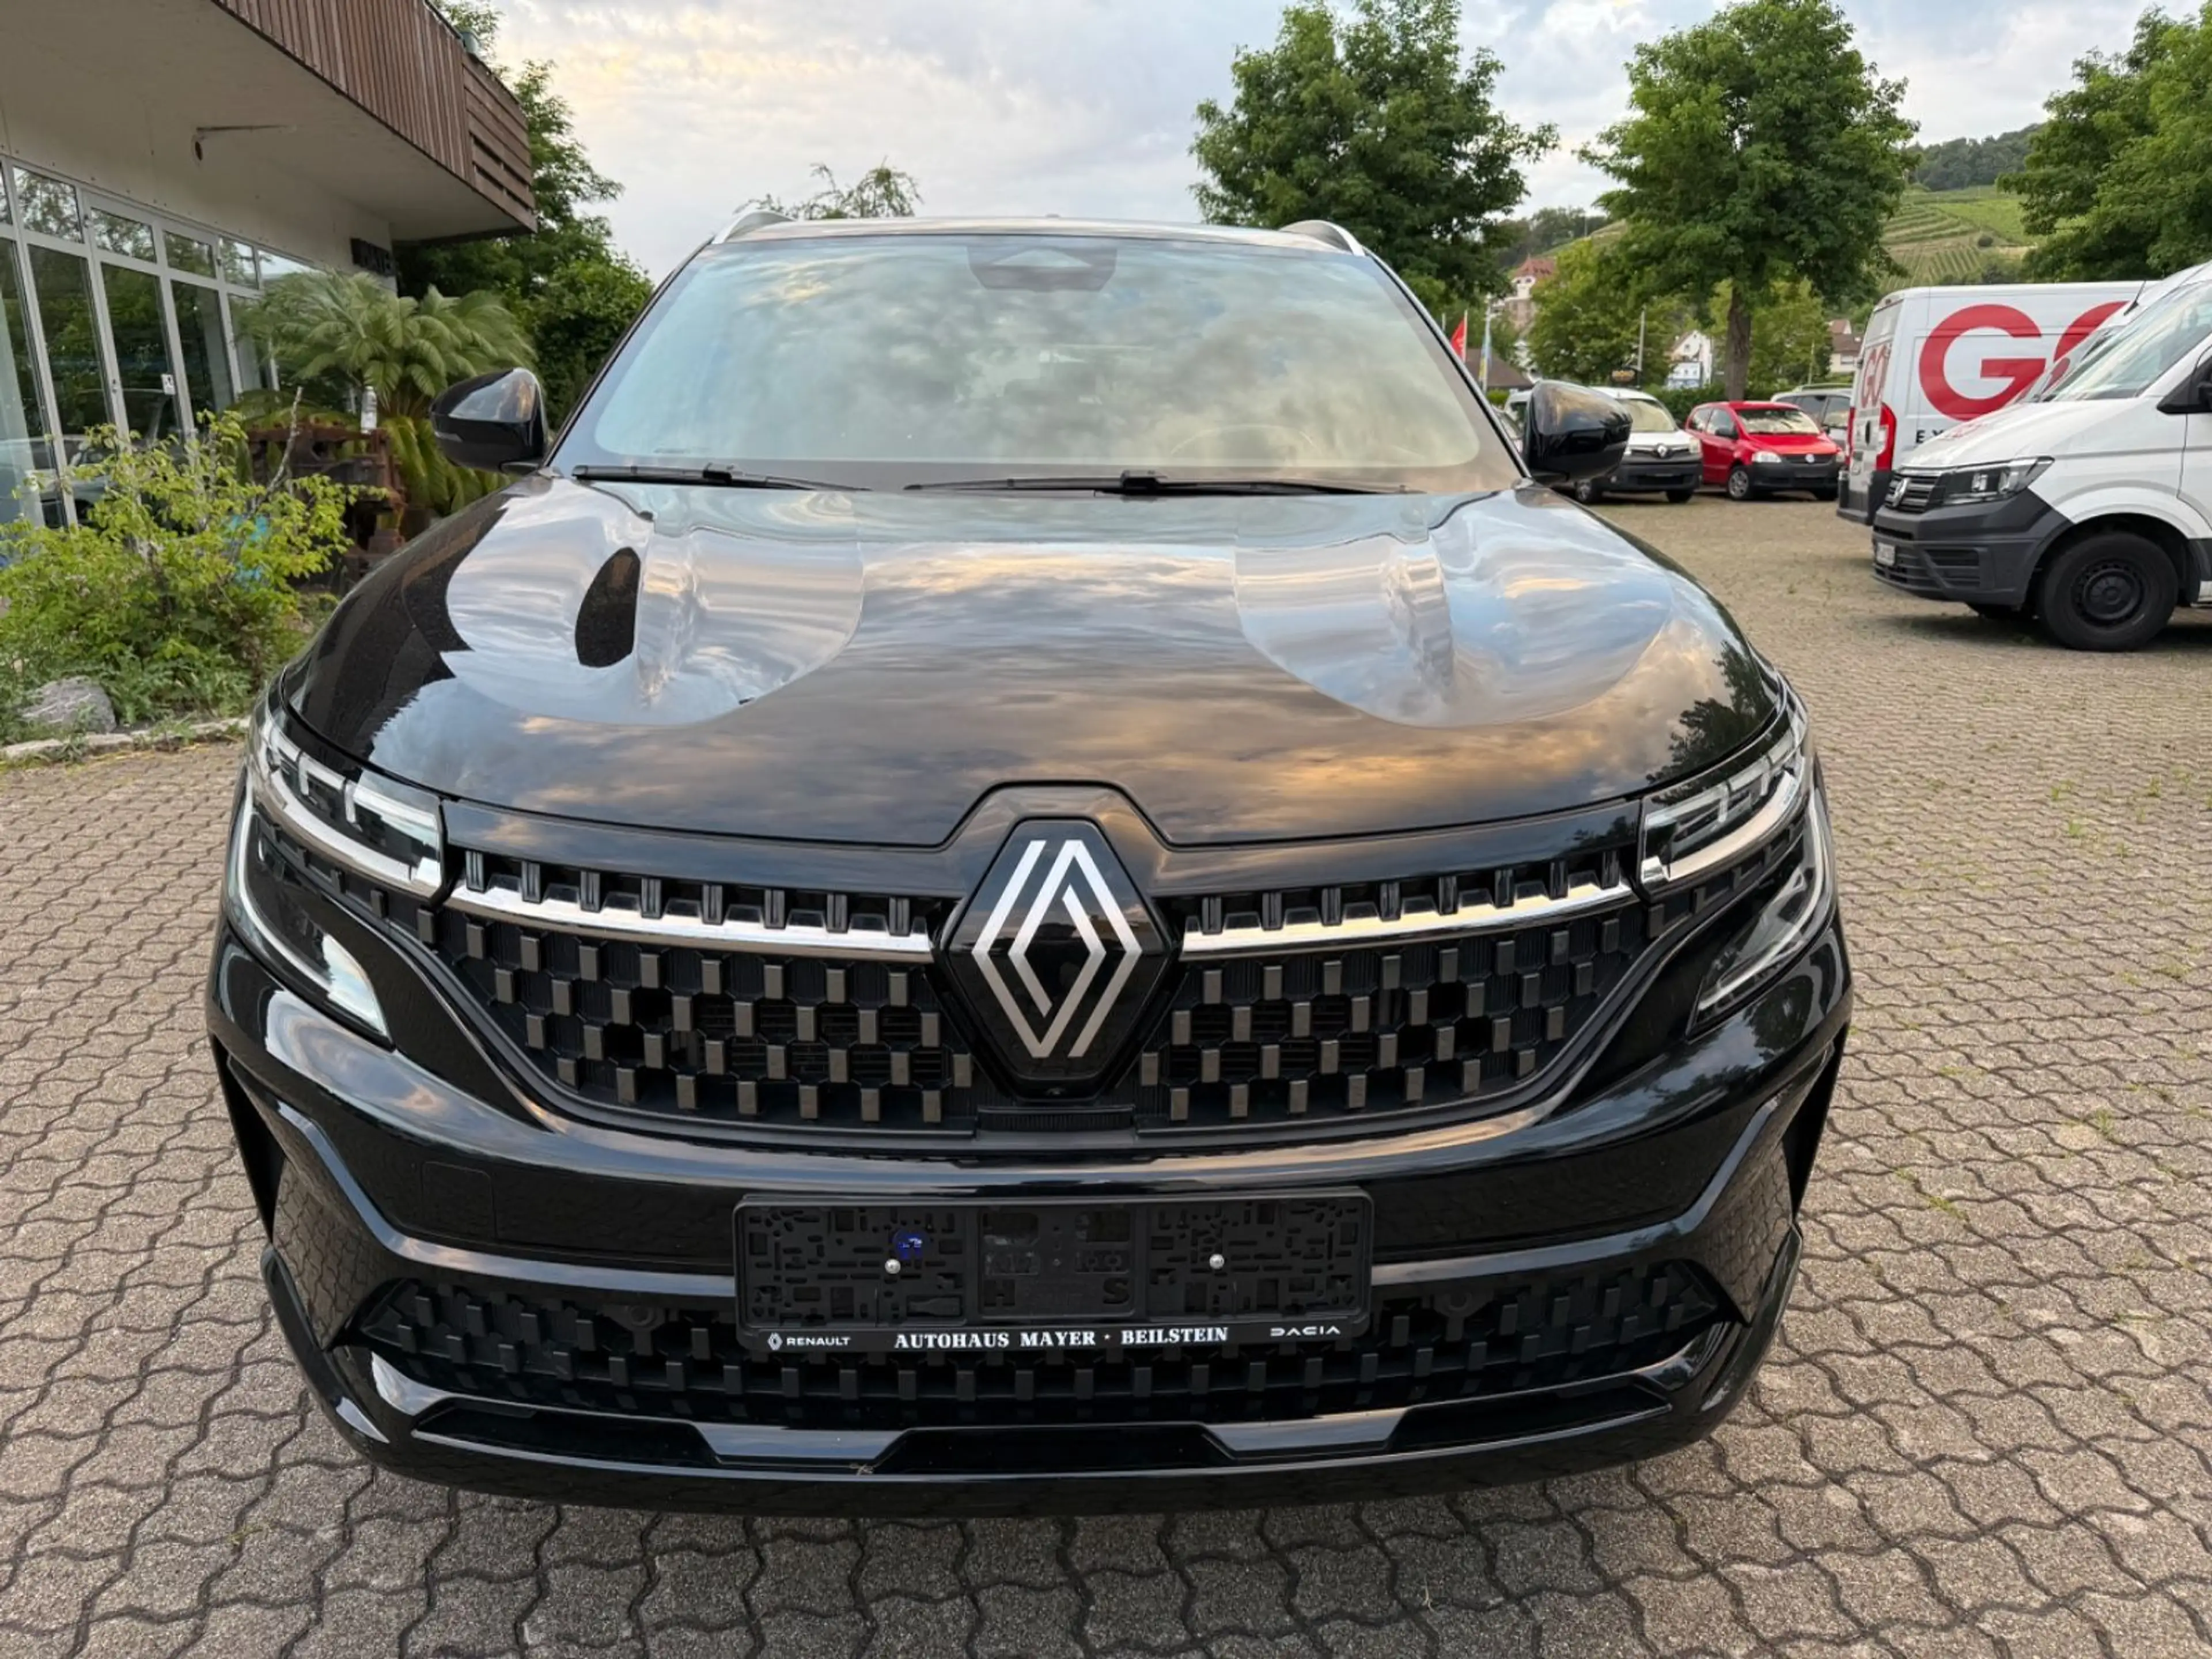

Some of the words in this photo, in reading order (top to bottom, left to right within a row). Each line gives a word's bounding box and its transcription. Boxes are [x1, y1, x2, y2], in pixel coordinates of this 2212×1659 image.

[1270, 1325, 1341, 1337] DACIA
[786, 1336, 851, 1347] RENAULT
[894, 1332, 1009, 1349] AUTOHAUS
[1020, 1331, 1096, 1347] MAYER
[1121, 1327, 1229, 1345] BEILSTEIN
